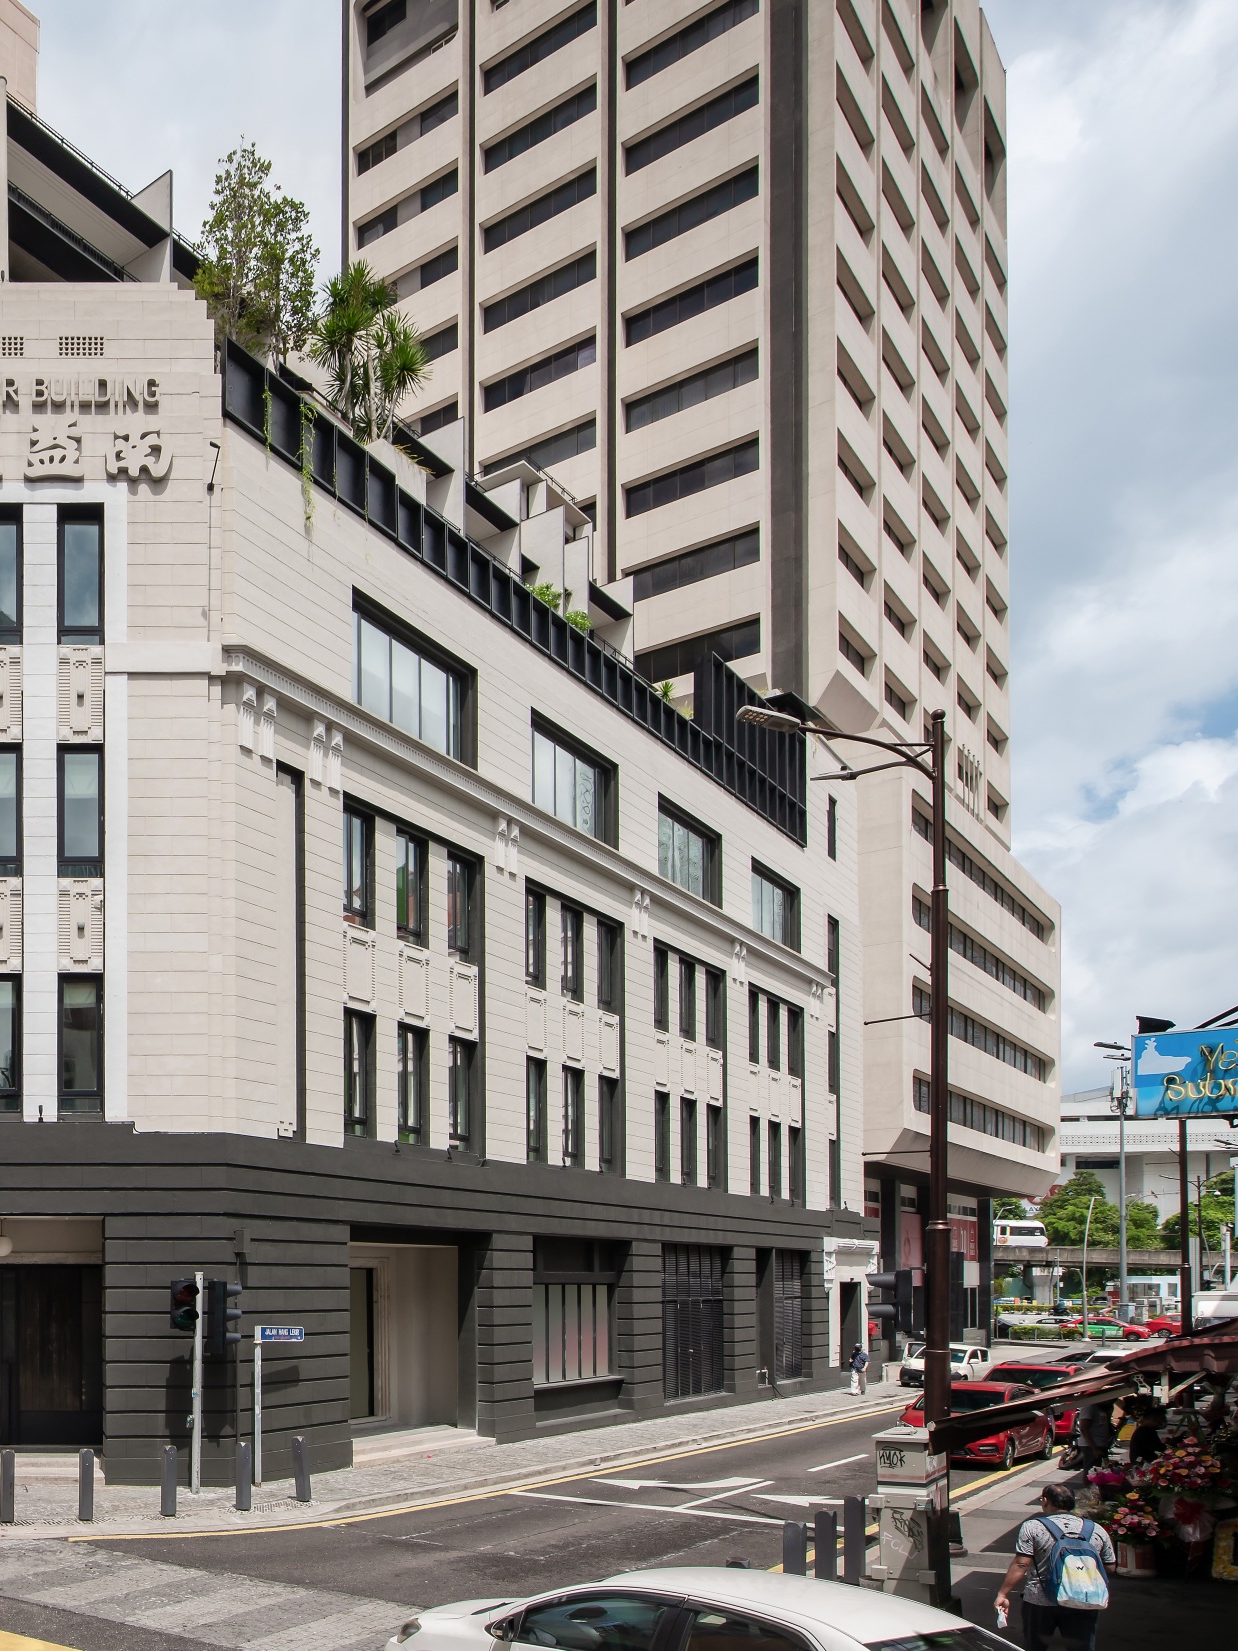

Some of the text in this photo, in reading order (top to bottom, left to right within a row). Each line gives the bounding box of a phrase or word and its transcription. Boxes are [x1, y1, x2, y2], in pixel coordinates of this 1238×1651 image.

[31, 377, 160, 405] BUILDING
[1199, 1039, 1238, 1071] Ye
[264, 1328, 277, 1336] JALAN
